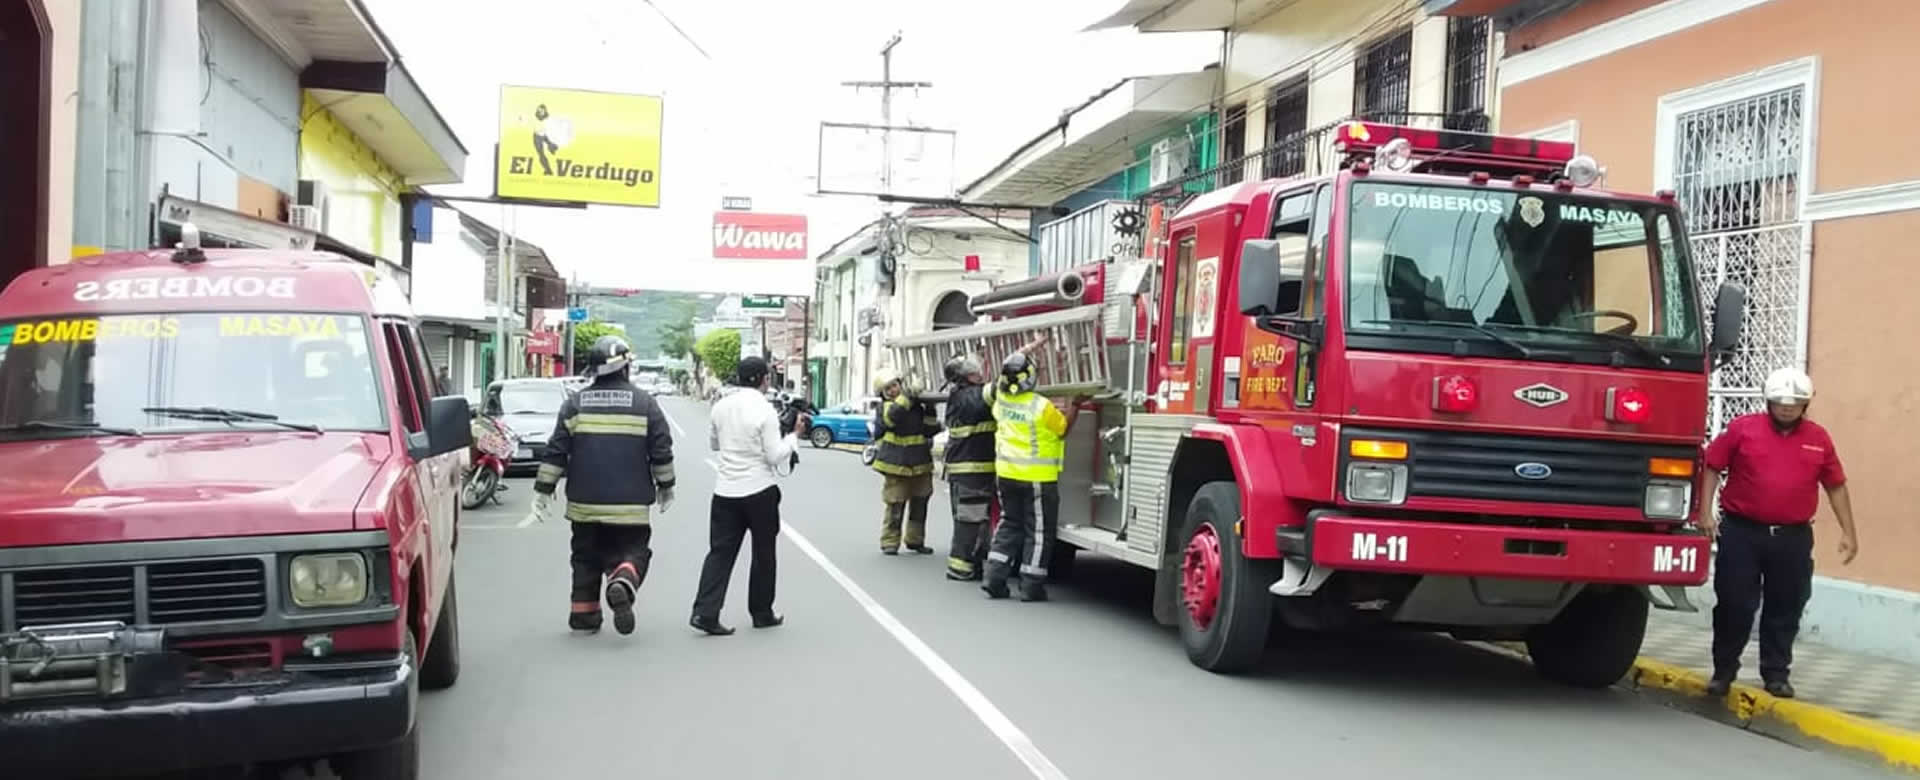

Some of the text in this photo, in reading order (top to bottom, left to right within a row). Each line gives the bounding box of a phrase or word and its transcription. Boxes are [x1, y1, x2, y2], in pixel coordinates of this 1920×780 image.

[509, 156, 654, 187] El Verdugo
[1375, 192, 1643, 226] BOMBEROS MASAYA
[714, 222, 805, 251] Wawa
[13, 317, 341, 345] BOMBEROS MASAYA
[1251, 344, 1286, 366] FARO
[1247, 376, 1264, 393] FIRE
[1352, 532, 1408, 562] M-11
[1653, 546, 1697, 573] M-11
